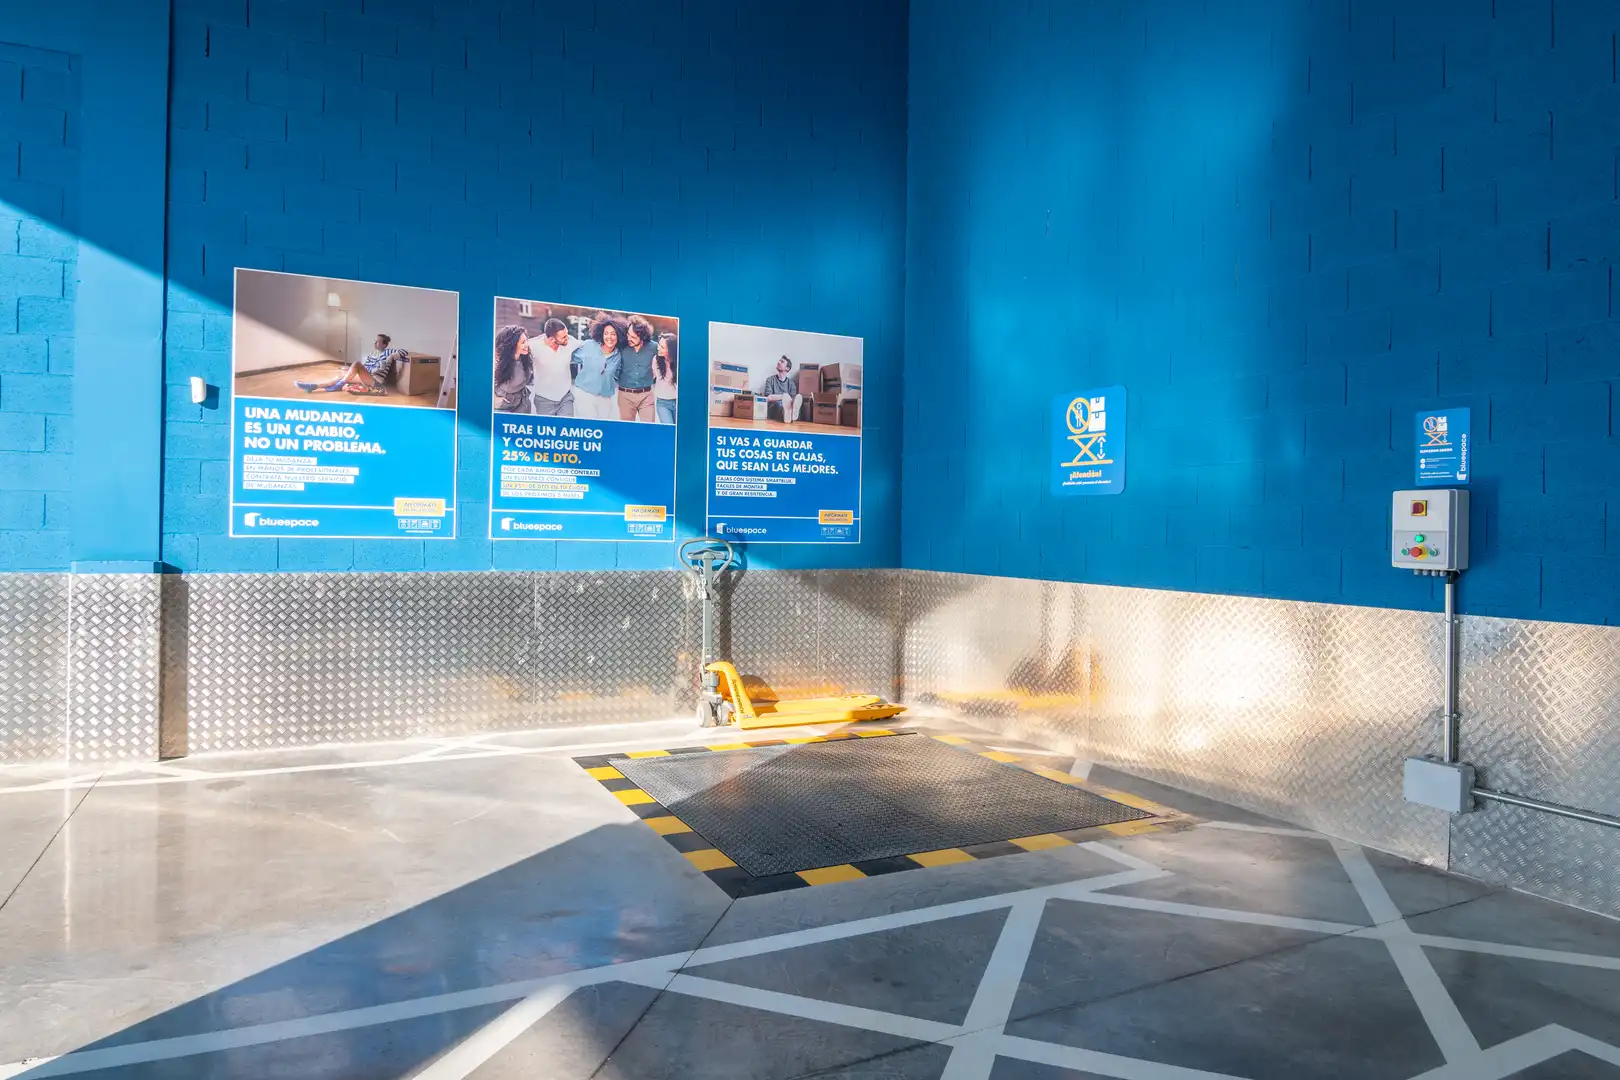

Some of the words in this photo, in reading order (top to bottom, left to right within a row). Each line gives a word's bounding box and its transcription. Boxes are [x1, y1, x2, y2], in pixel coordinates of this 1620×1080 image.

[245, 407, 281, 420] UNA
[285, 408, 364, 424] MUDANZA
[244, 422, 261, 434] ES
[267, 423, 290, 436] UN
[295, 424, 360, 439] CAMBIO,
[503, 424, 533, 435] TRAE
[537, 426, 556, 436] UN
[560, 427, 603, 439] AMIGO
[244, 437, 271, 450] NO
[276, 438, 298, 450] UN
[304, 440, 386, 454] PROBLEMA.
[502, 437, 511, 447] Y
[515, 438, 579, 450] CONSIGUE
[583, 441, 601, 452] UN
[717, 436, 726, 445] SI
[730, 437, 750, 446] VAS
[753, 438, 760, 447] A
[763, 439, 813, 450] GUARDAR
[502, 450, 530, 462] 25%
[534, 452, 549, 462] DE
[553, 453, 582, 464] DTO.
[717, 448, 736, 458] TUS
[739, 449, 773, 460] COSAS
[776, 451, 789, 460] EN
[792, 452, 826, 463] CAJAS,
[716, 460, 738, 470] QUE
[742, 462, 768, 471] SEAN
[772, 463, 789, 472] LAS
[793, 464, 838, 474] MEJORES.
[259, 517, 319, 528] bluespace
[513, 521, 563, 531] bluespace
